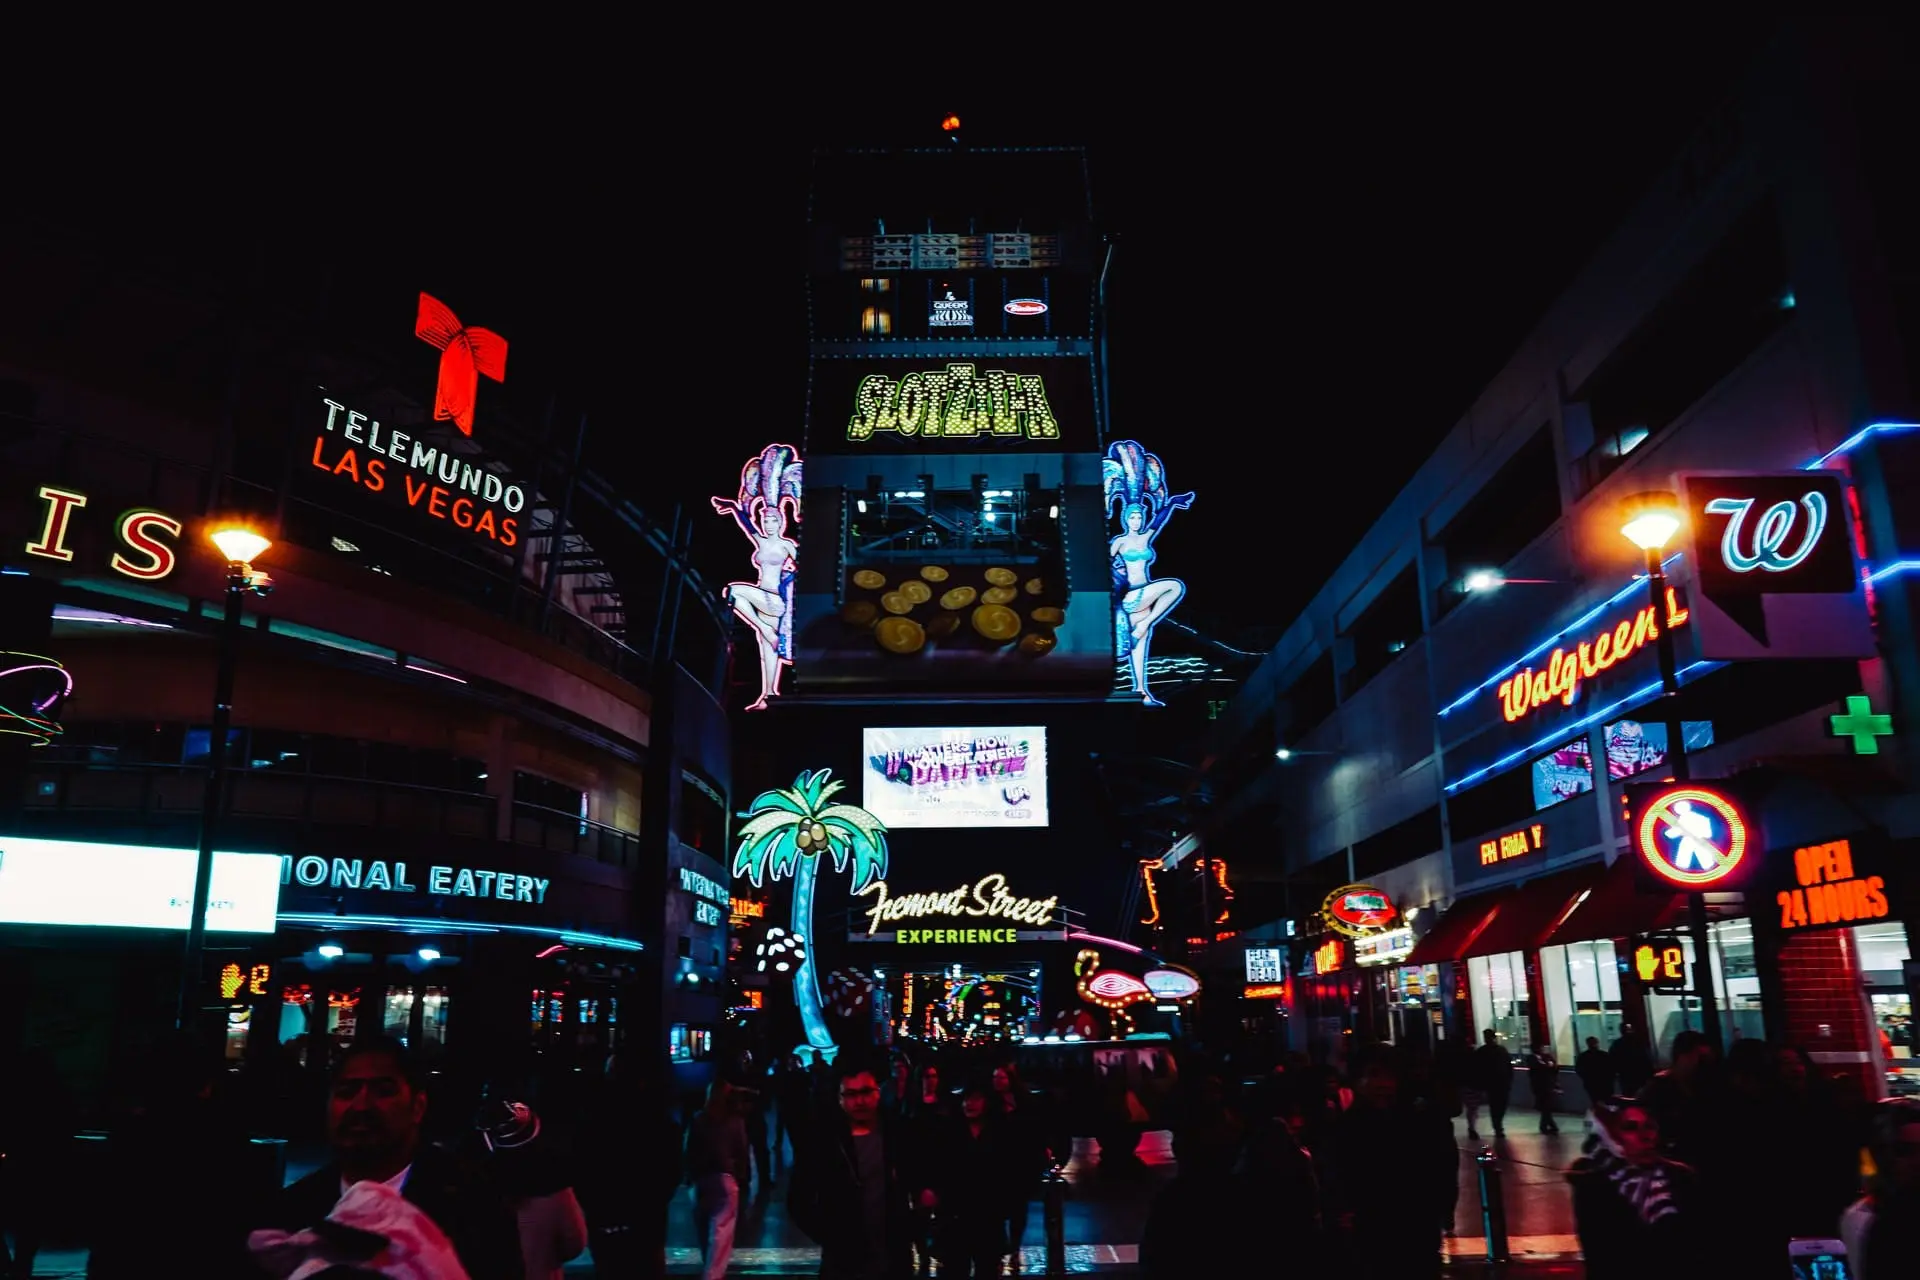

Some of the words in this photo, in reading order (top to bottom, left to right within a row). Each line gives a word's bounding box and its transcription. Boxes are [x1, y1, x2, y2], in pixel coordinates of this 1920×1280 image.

[321, 397, 526, 514] TELEMUNDO
[311, 435, 387, 492] LAS
[404, 473, 519, 548] VEGAS
[428, 865, 550, 904] EATERY
[1794, 839, 1855, 886] OPEN
[859, 880, 968, 935] Fremont
[965, 873, 1059, 926] Street
[1776, 889, 1807, 928] 24
[1806, 874, 1889, 926] HOURS
[896, 928, 1017, 944] EXPERIENCE
